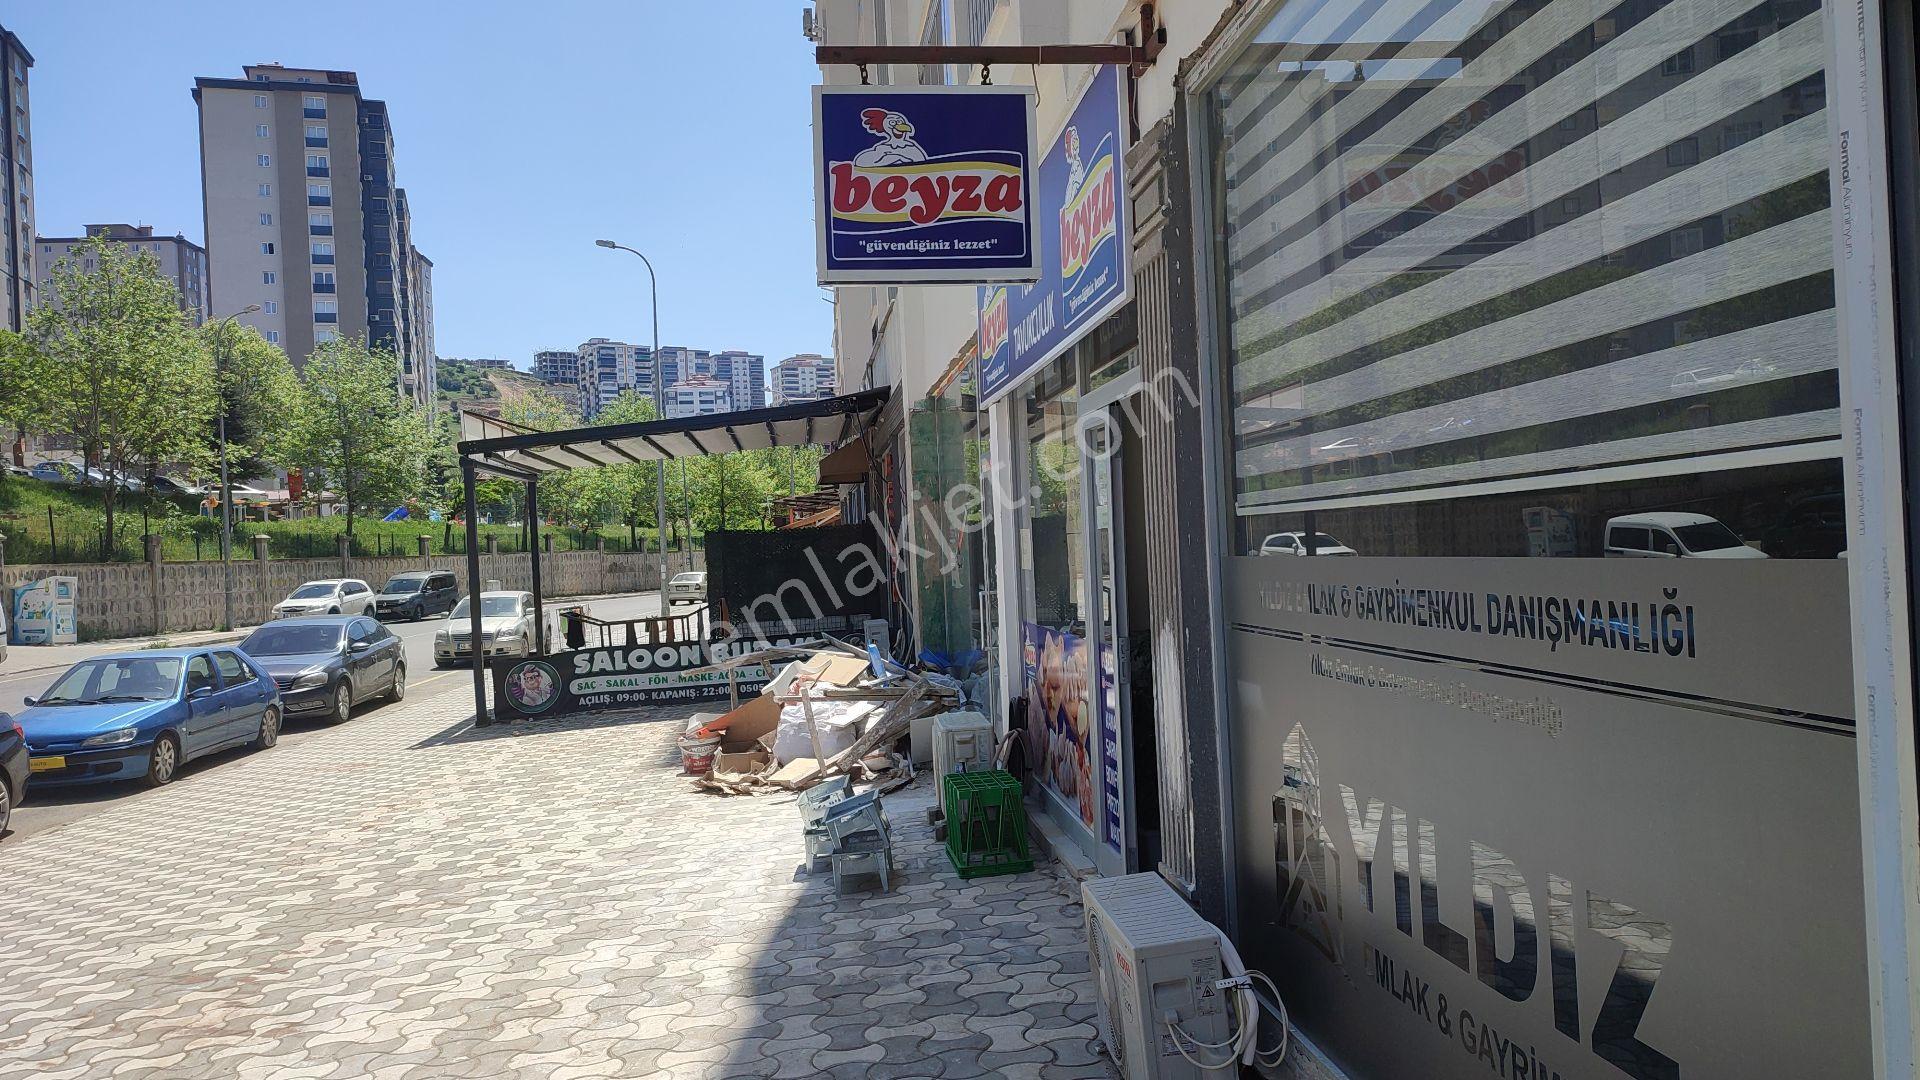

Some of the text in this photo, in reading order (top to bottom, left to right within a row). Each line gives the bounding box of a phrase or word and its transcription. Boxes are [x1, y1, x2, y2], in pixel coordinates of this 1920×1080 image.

[1841, 130, 1851, 185] Formal
[831, 163, 1023, 224] beyza
[1060, 166, 1114, 269] beyza
[954, 238, 998, 250] lezzet"
[1854, 408, 1864, 461] Formal
[1340, 584, 1352, 618] &
[1355, 578, 1481, 632] GAYRİMENKUL
[1486, 587, 1696, 658] DANIŞMANLIĞI
[573, 645, 700, 675] SALOON
[605, 678, 640, 687] SAKAL
[578, 694, 614, 707] AÇILIŞ:
[651, 689, 700, 700] KAPANIŞ:
[1339, 783, 1680, 1080] YILDIZ
[1436, 992, 1454, 1040] &
